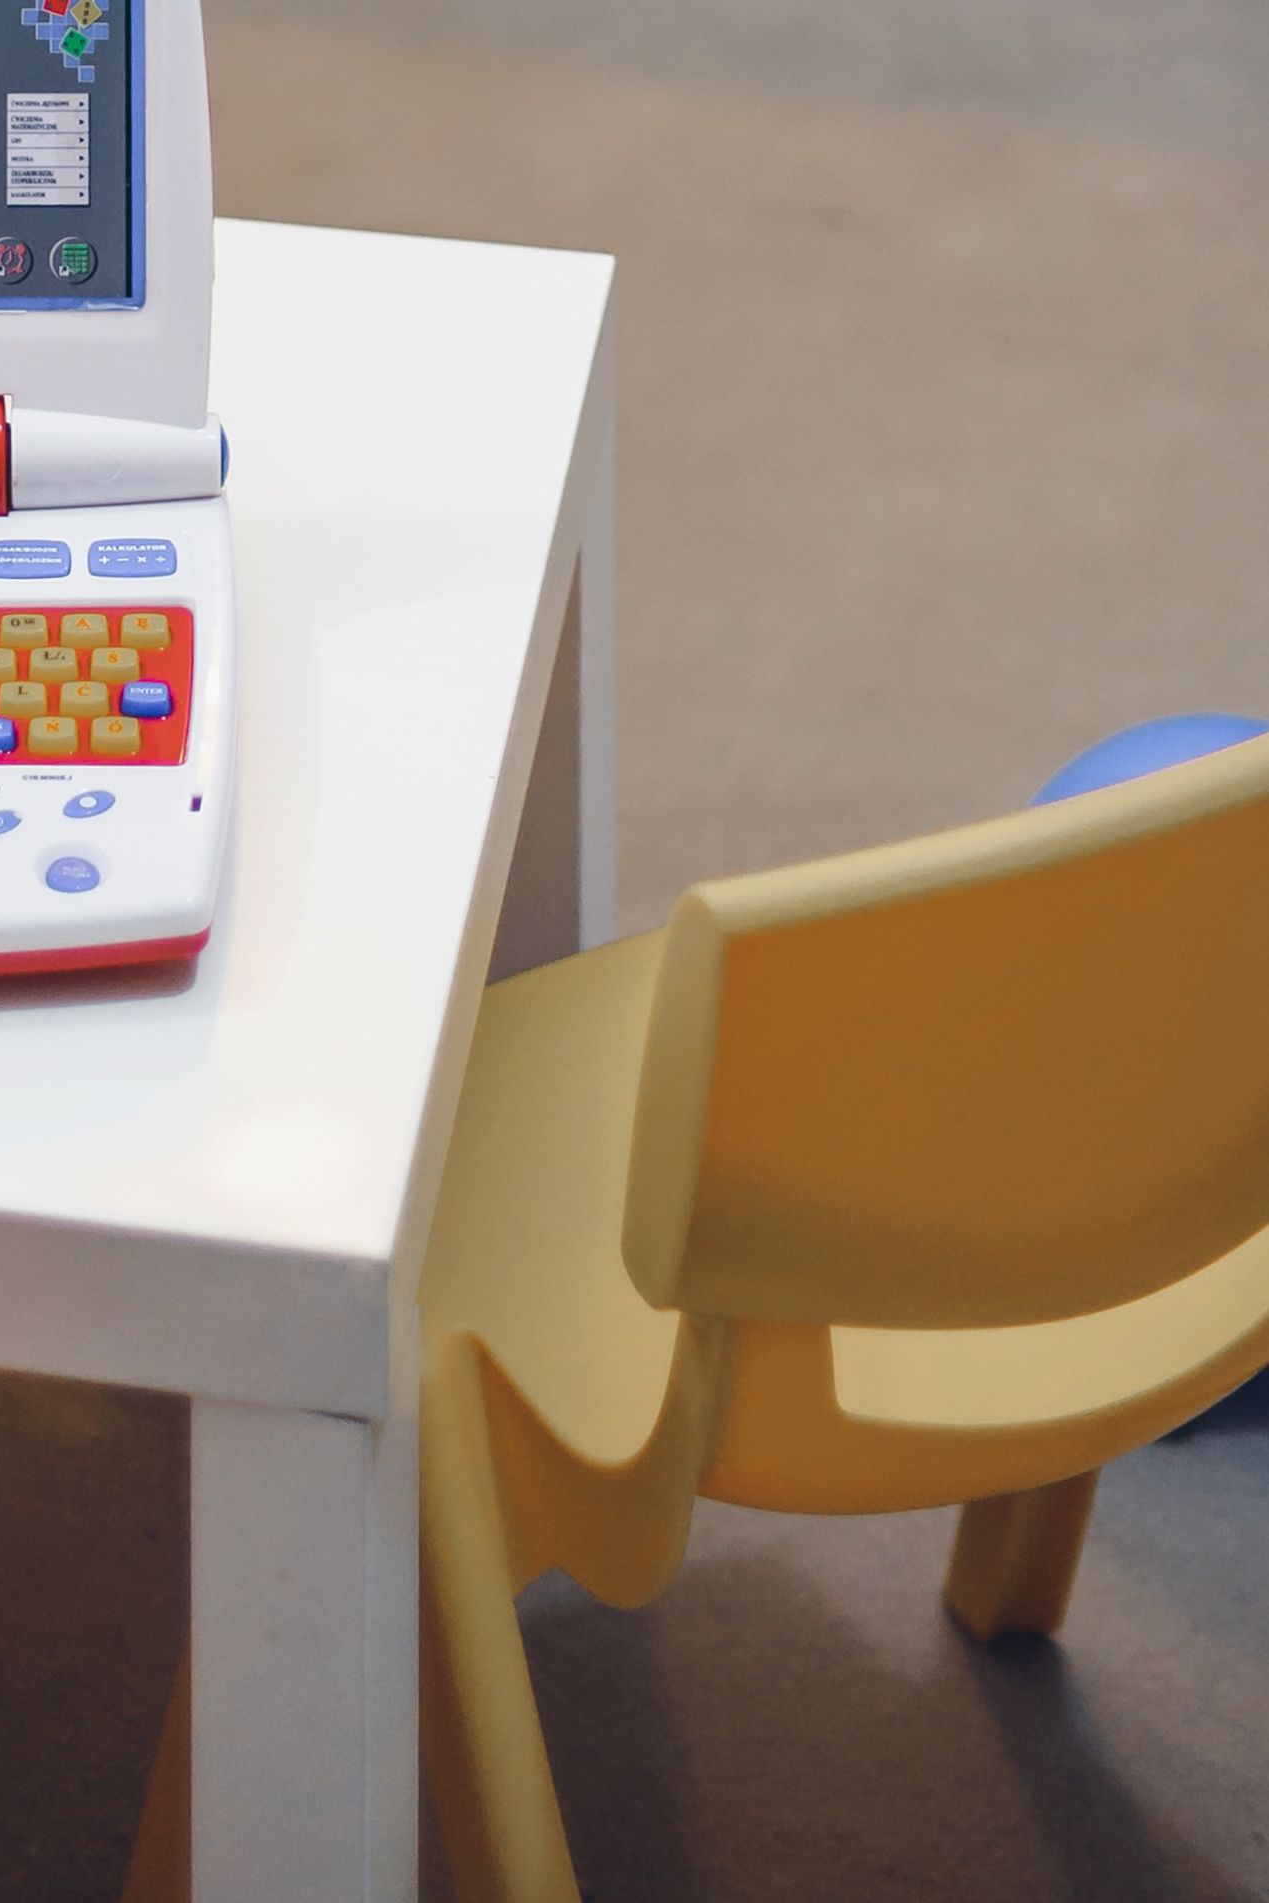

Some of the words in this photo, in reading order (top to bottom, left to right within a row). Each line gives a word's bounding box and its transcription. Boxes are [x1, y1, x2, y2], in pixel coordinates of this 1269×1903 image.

[98, 544, 167, 552] KALKULATOR
[10, 618, 21, 627] 0
[17, 686, 28, 695] L
[78, 683, 92, 696] Ć
[130, 687, 163, 695] ENTER
[46, 719, 59, 732] Ń
[108, 720, 122, 733] Ó
